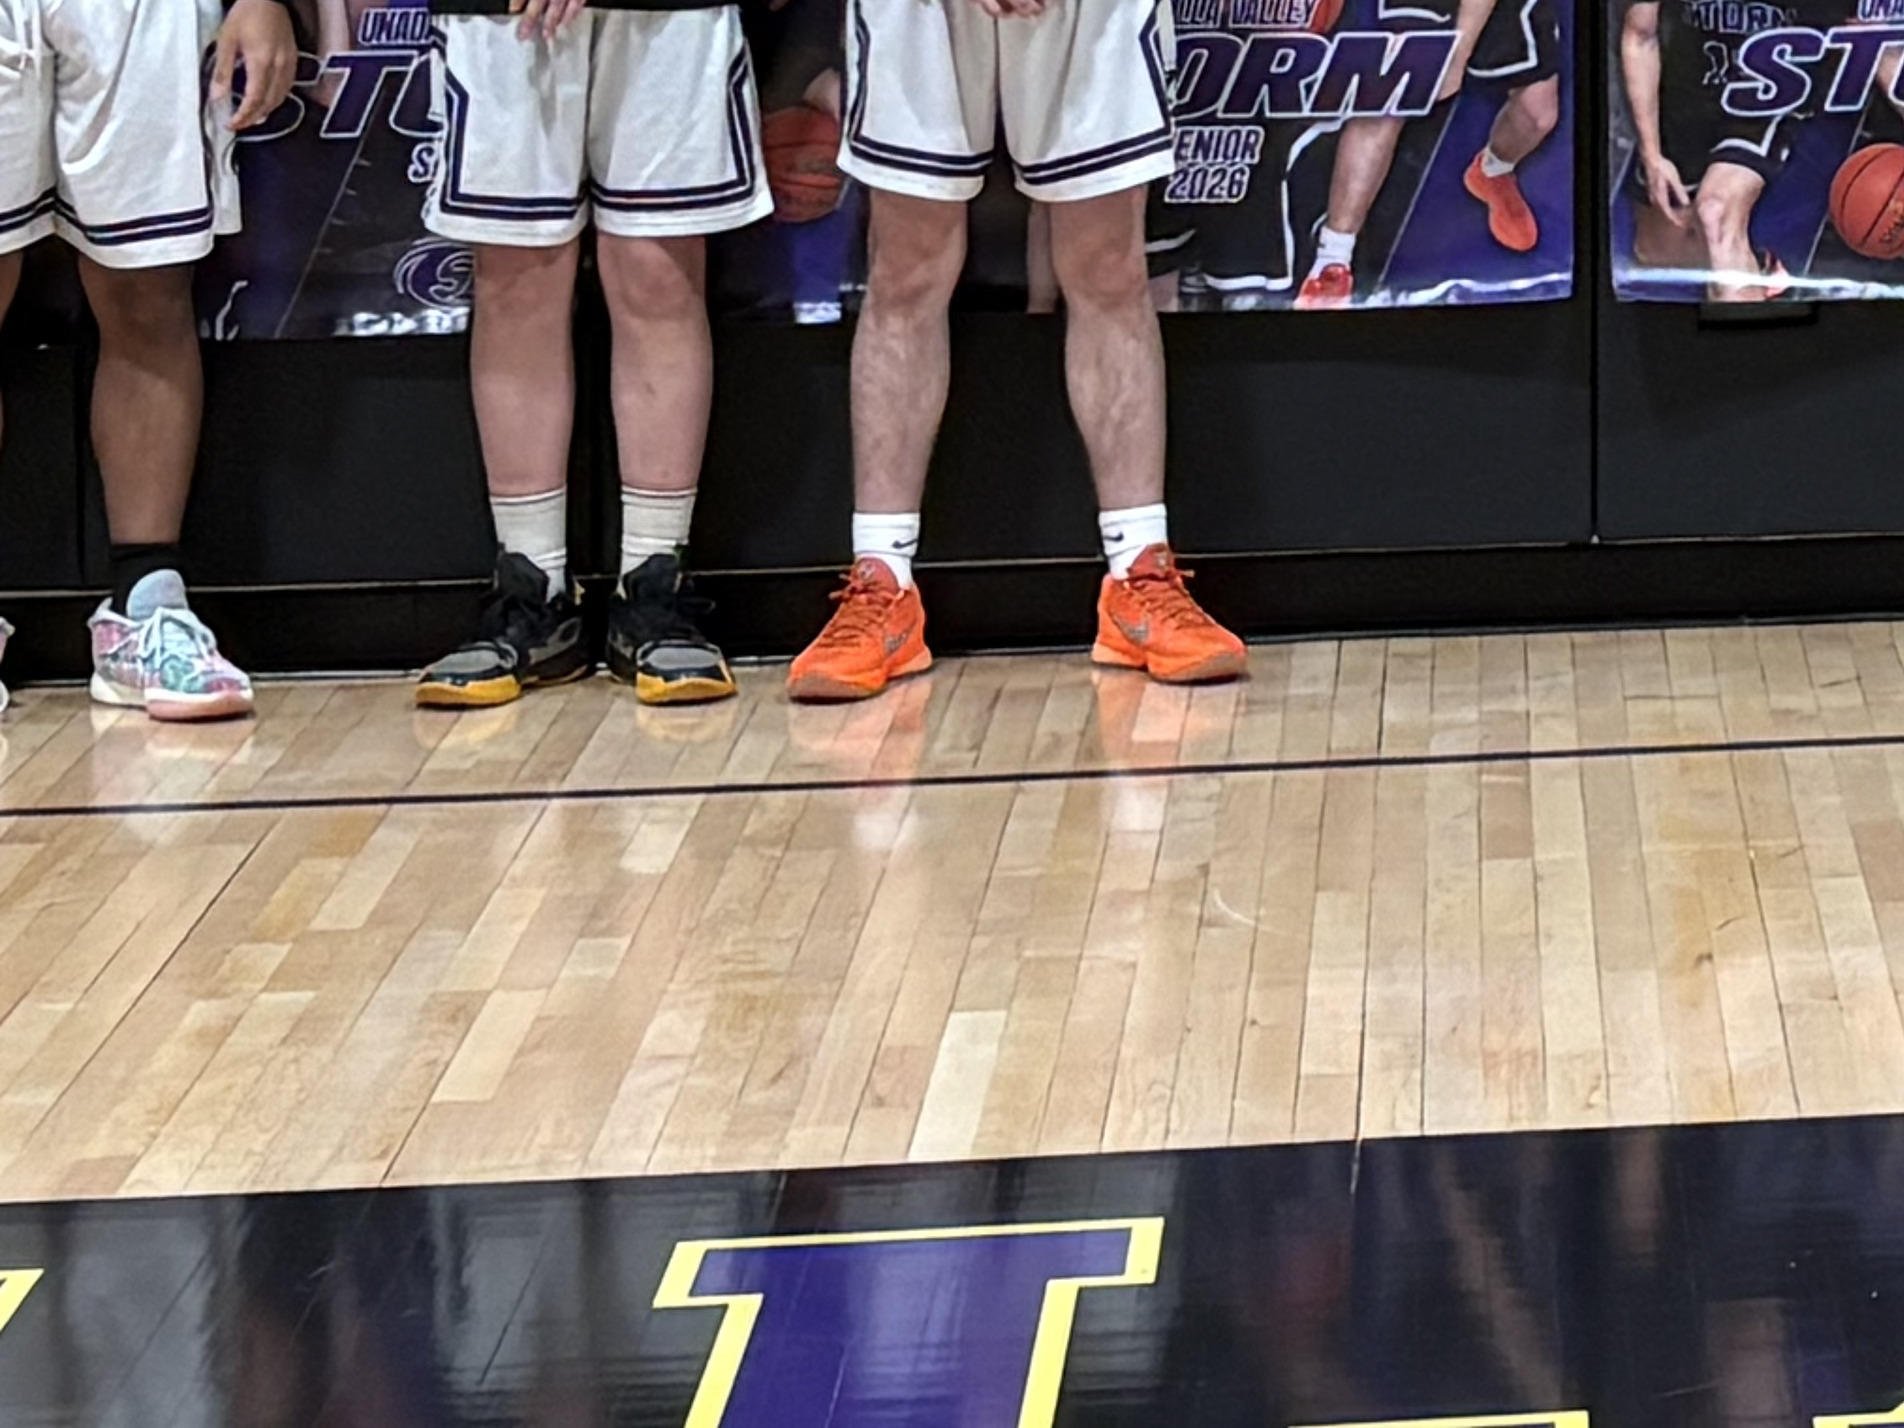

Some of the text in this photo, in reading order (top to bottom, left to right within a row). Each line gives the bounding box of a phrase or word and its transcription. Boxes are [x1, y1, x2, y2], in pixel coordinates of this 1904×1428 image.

[1173, 30, 1462, 121] ORM
[1173, 125, 1265, 165] ENIOR
[1163, 163, 1251, 204] 2026
